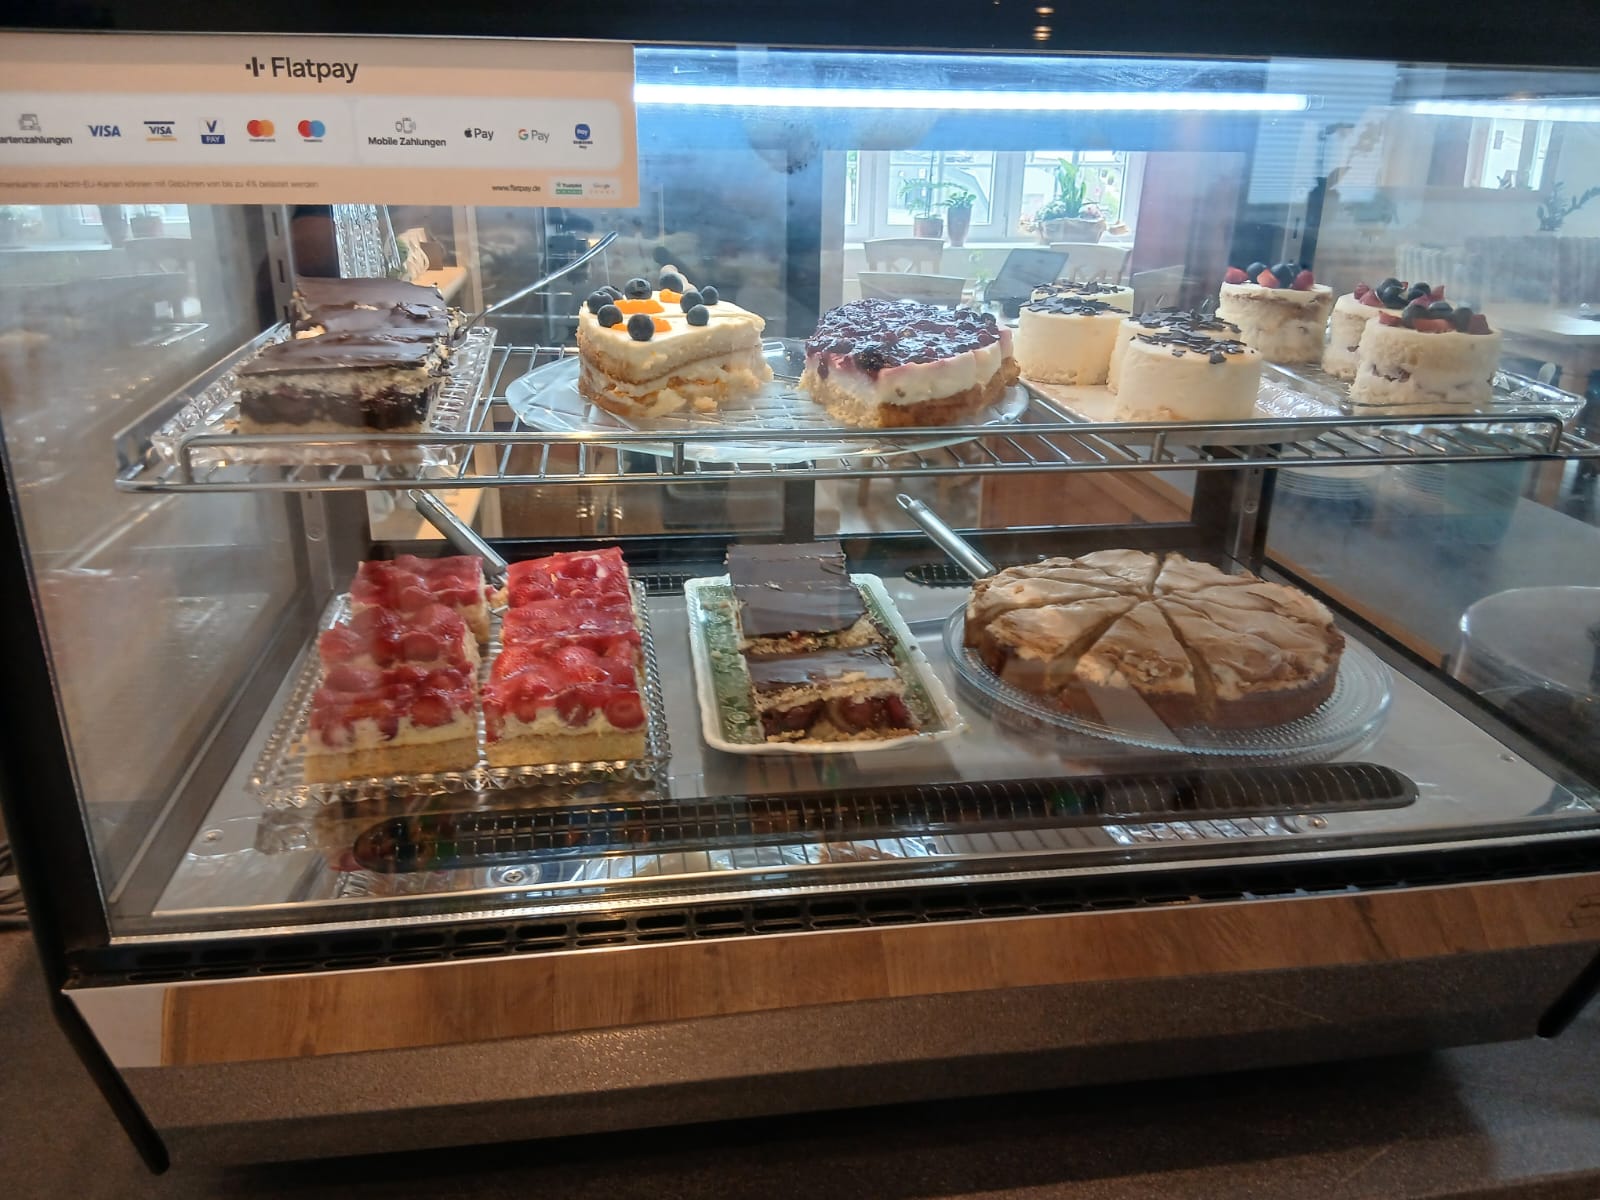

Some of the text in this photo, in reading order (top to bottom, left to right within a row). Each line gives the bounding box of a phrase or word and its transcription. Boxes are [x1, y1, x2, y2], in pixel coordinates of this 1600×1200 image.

[271, 56, 359, 84] Flatpay
[88, 124, 121, 138] VISA
[149, 126, 173, 135] VISA
[474, 128, 494, 141] Pay
[531, 129, 549, 143] Pay
[0, 136, 73, 146] artenzahlungen
[206, 135, 221, 144] PAY
[368, 137, 447, 148] Mobile Zahlungen
